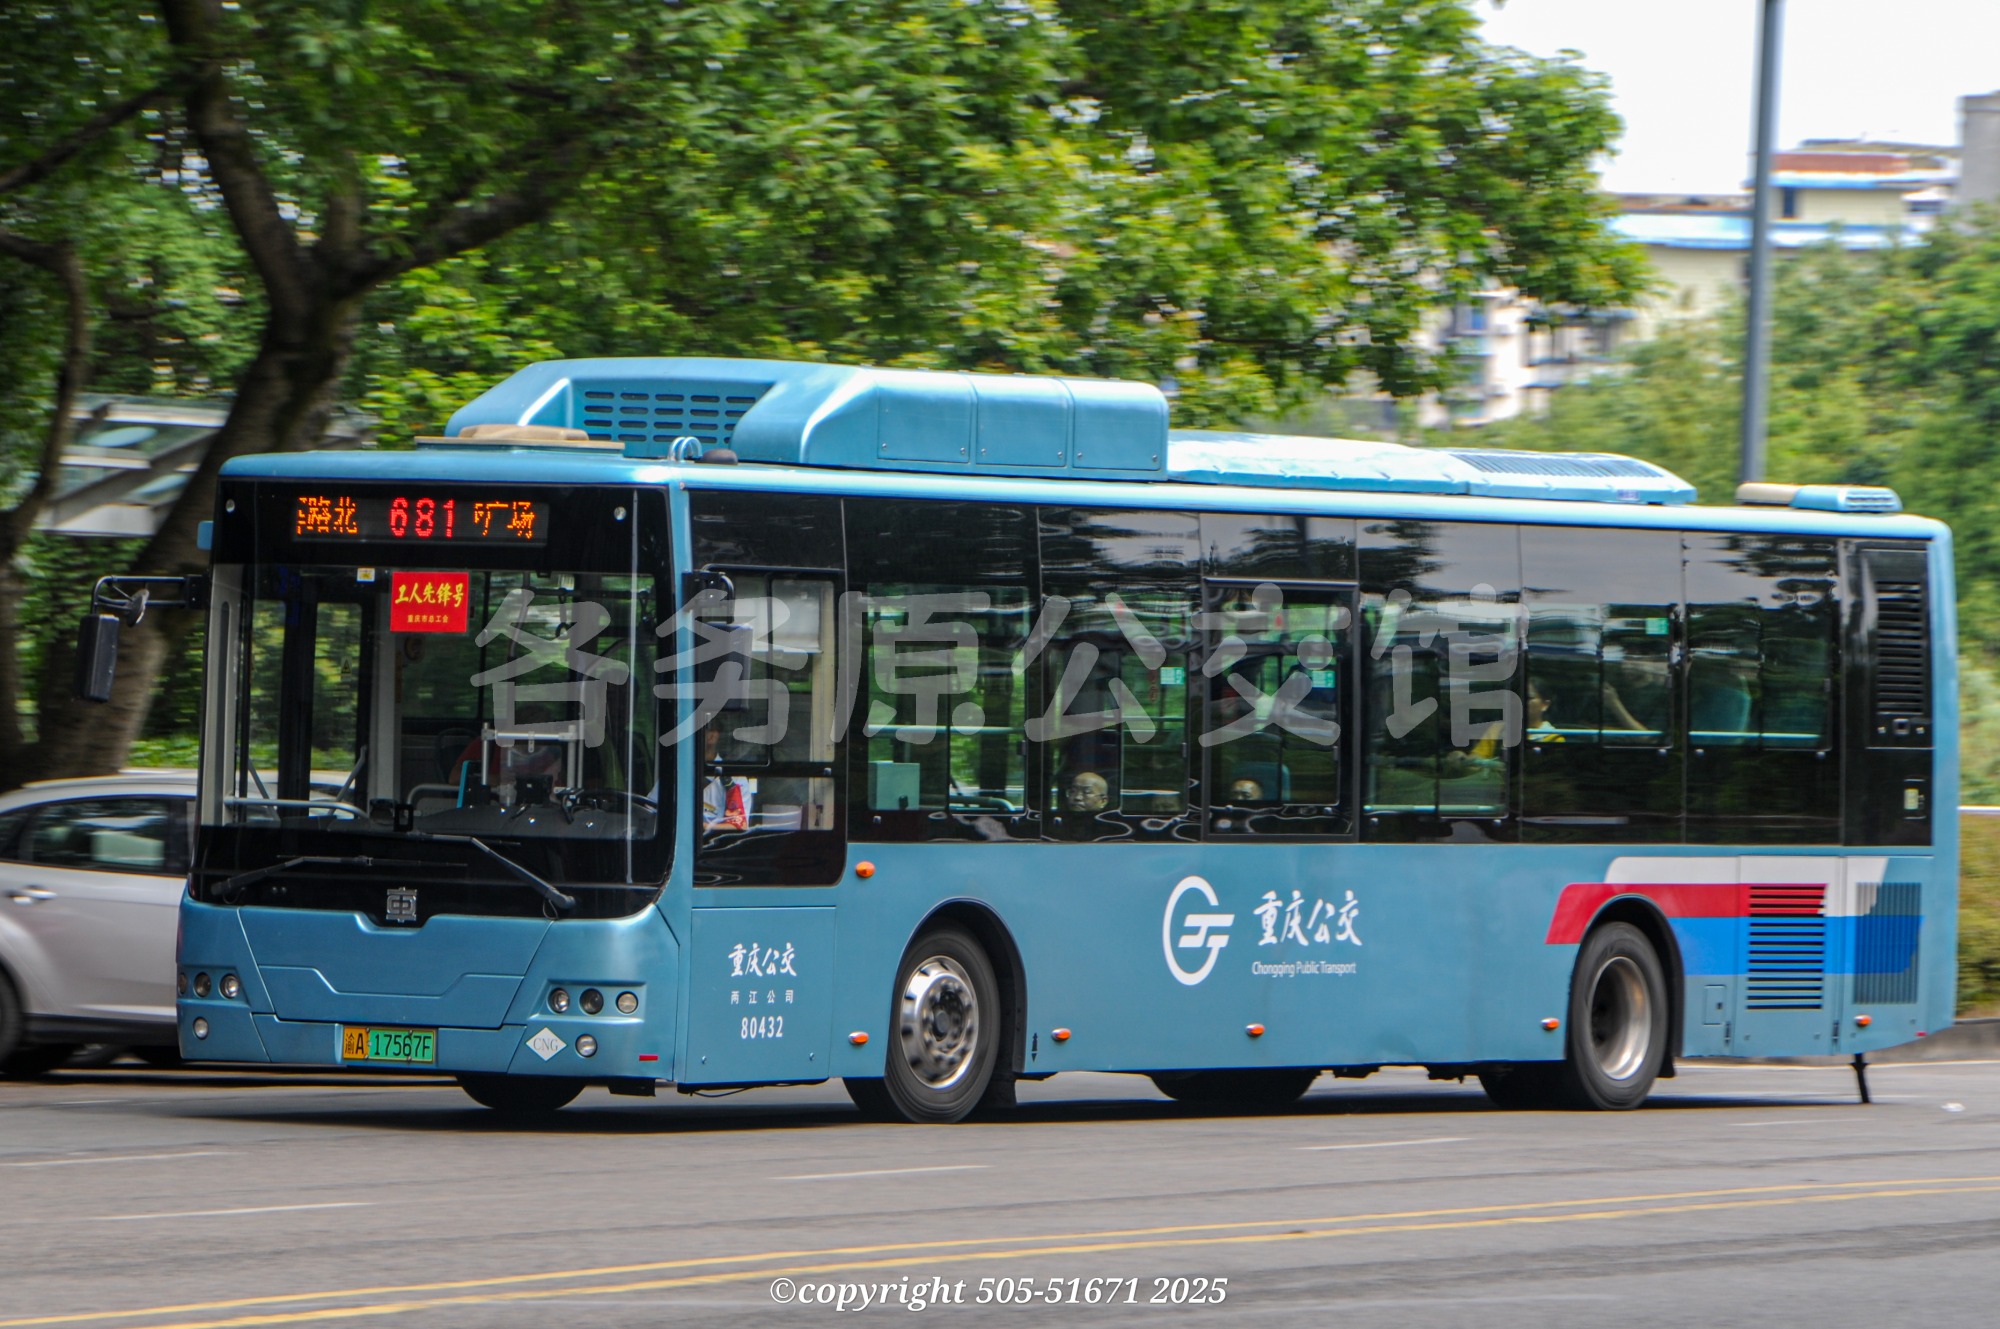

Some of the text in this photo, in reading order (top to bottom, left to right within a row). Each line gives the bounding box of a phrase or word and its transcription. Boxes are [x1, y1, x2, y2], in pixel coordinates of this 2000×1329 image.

[390, 497, 455, 538] 681
[395, 582, 464, 608] 工人先锋号
[407, 614, 449, 623] 重庆市总工会
[1253, 890, 1362, 946] 重庆公交
[728, 942, 797, 977] 重庆公交
[1252, 961, 1357, 978] Chongqing Public Transport
[730, 989, 794, 1005] 两江公司
[741, 1016, 783, 1039] 80432
[533, 1038, 559, 1052] CNG
